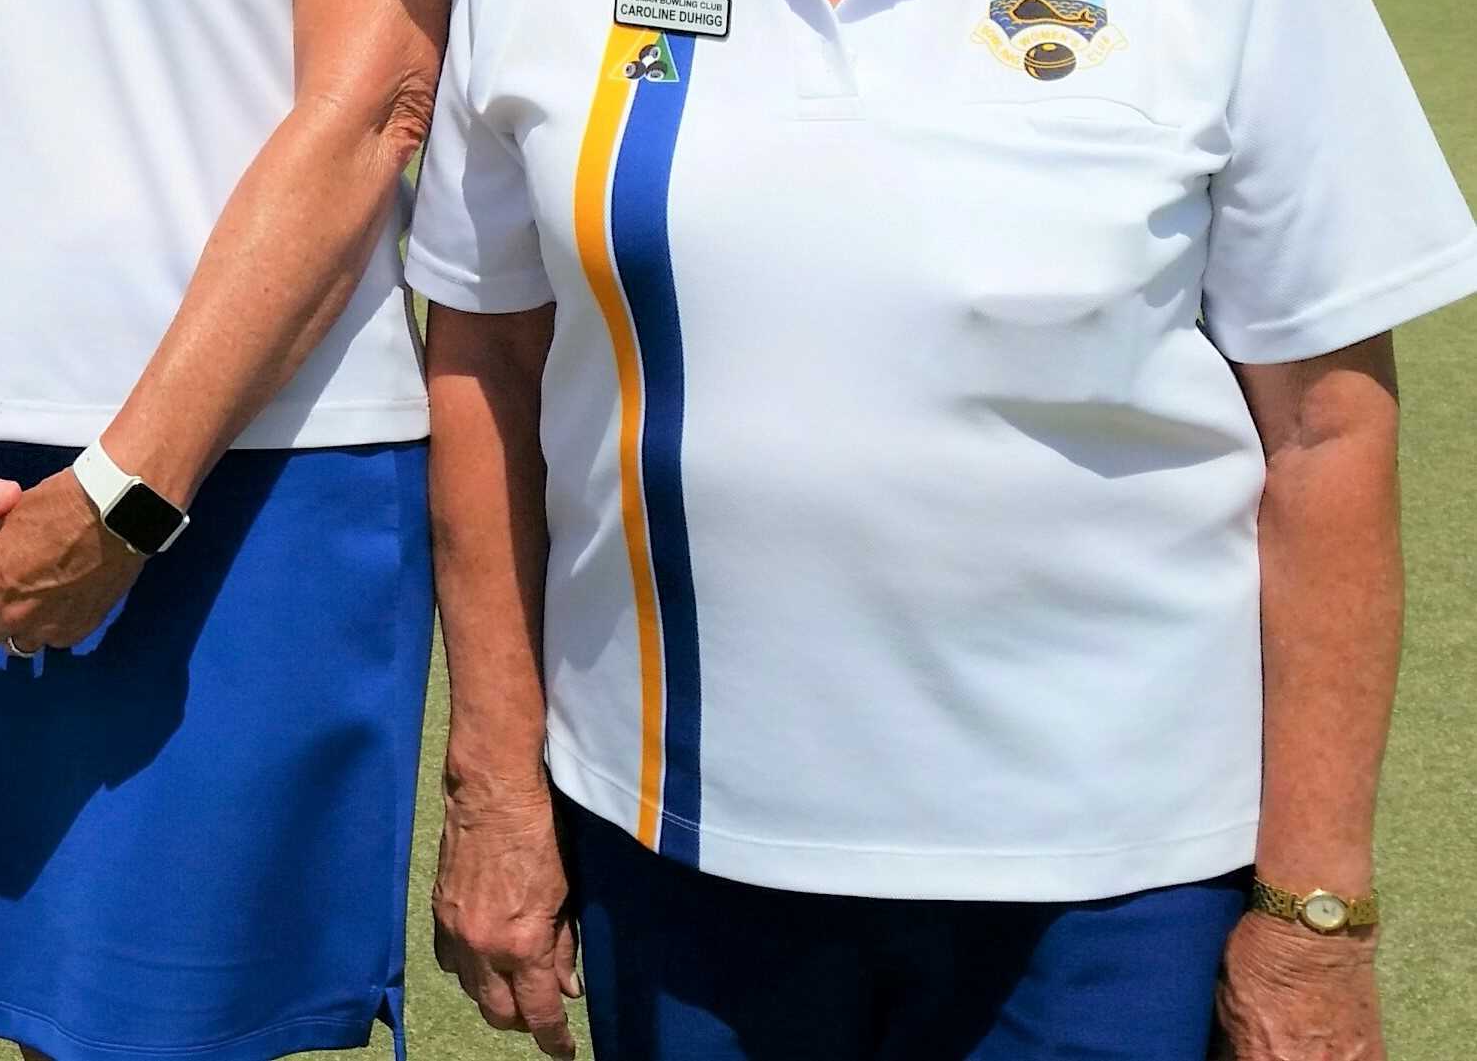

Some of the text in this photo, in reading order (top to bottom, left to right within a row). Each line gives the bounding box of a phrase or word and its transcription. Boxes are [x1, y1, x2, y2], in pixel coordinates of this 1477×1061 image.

[620, 3, 723, 27] CAROLINE DUHIGG
[699, 1, 723, 12] CLUB
